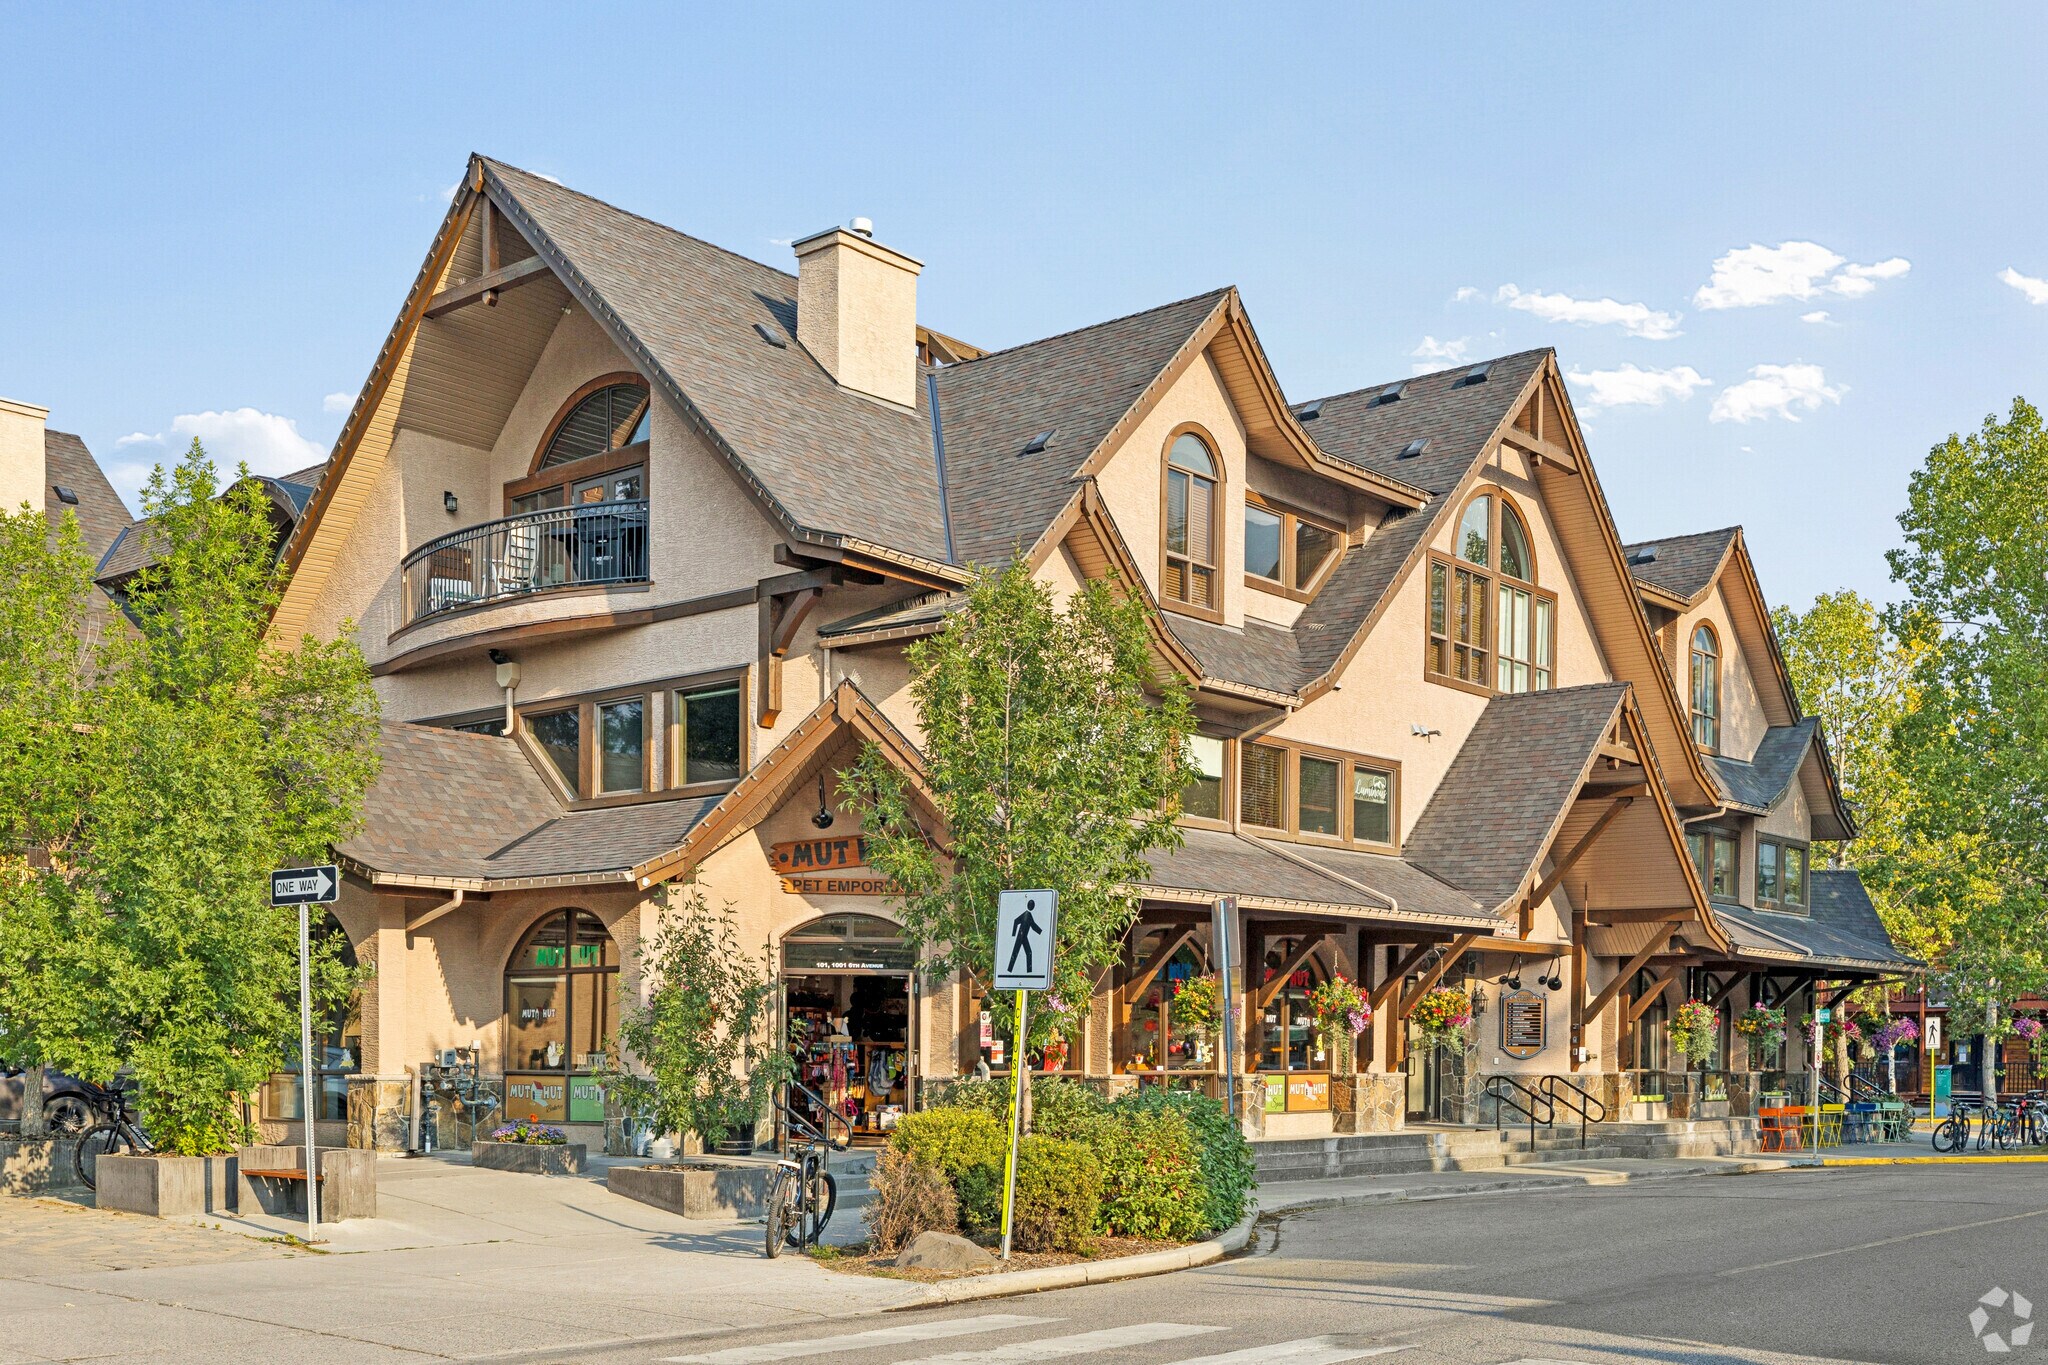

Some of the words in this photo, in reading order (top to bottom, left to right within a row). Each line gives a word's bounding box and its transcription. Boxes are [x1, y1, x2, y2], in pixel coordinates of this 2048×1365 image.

[792, 840, 849, 867] MUT
[276, 881, 294, 893] ONE
[299, 879, 318, 891] WAY
[793, 879, 823, 892] PET
[828, 880, 918, 893] EMPORU
[536, 947, 566, 966] MUT
[571, 945, 600, 966] HUT
[522, 1009, 536, 1018] MUT
[542, 1008, 556, 1018] HUT
[1007, 1007, 1020, 1155] CROSSWALK
[509, 1084, 531, 1099] MUT
[543, 1085, 563, 1099] HUT
[573, 1085, 595, 1100] MUT
[1268, 1084, 1283, 1096] HUT
[1289, 1083, 1305, 1095] MUT
[1313, 1083, 1327, 1095] HUT
